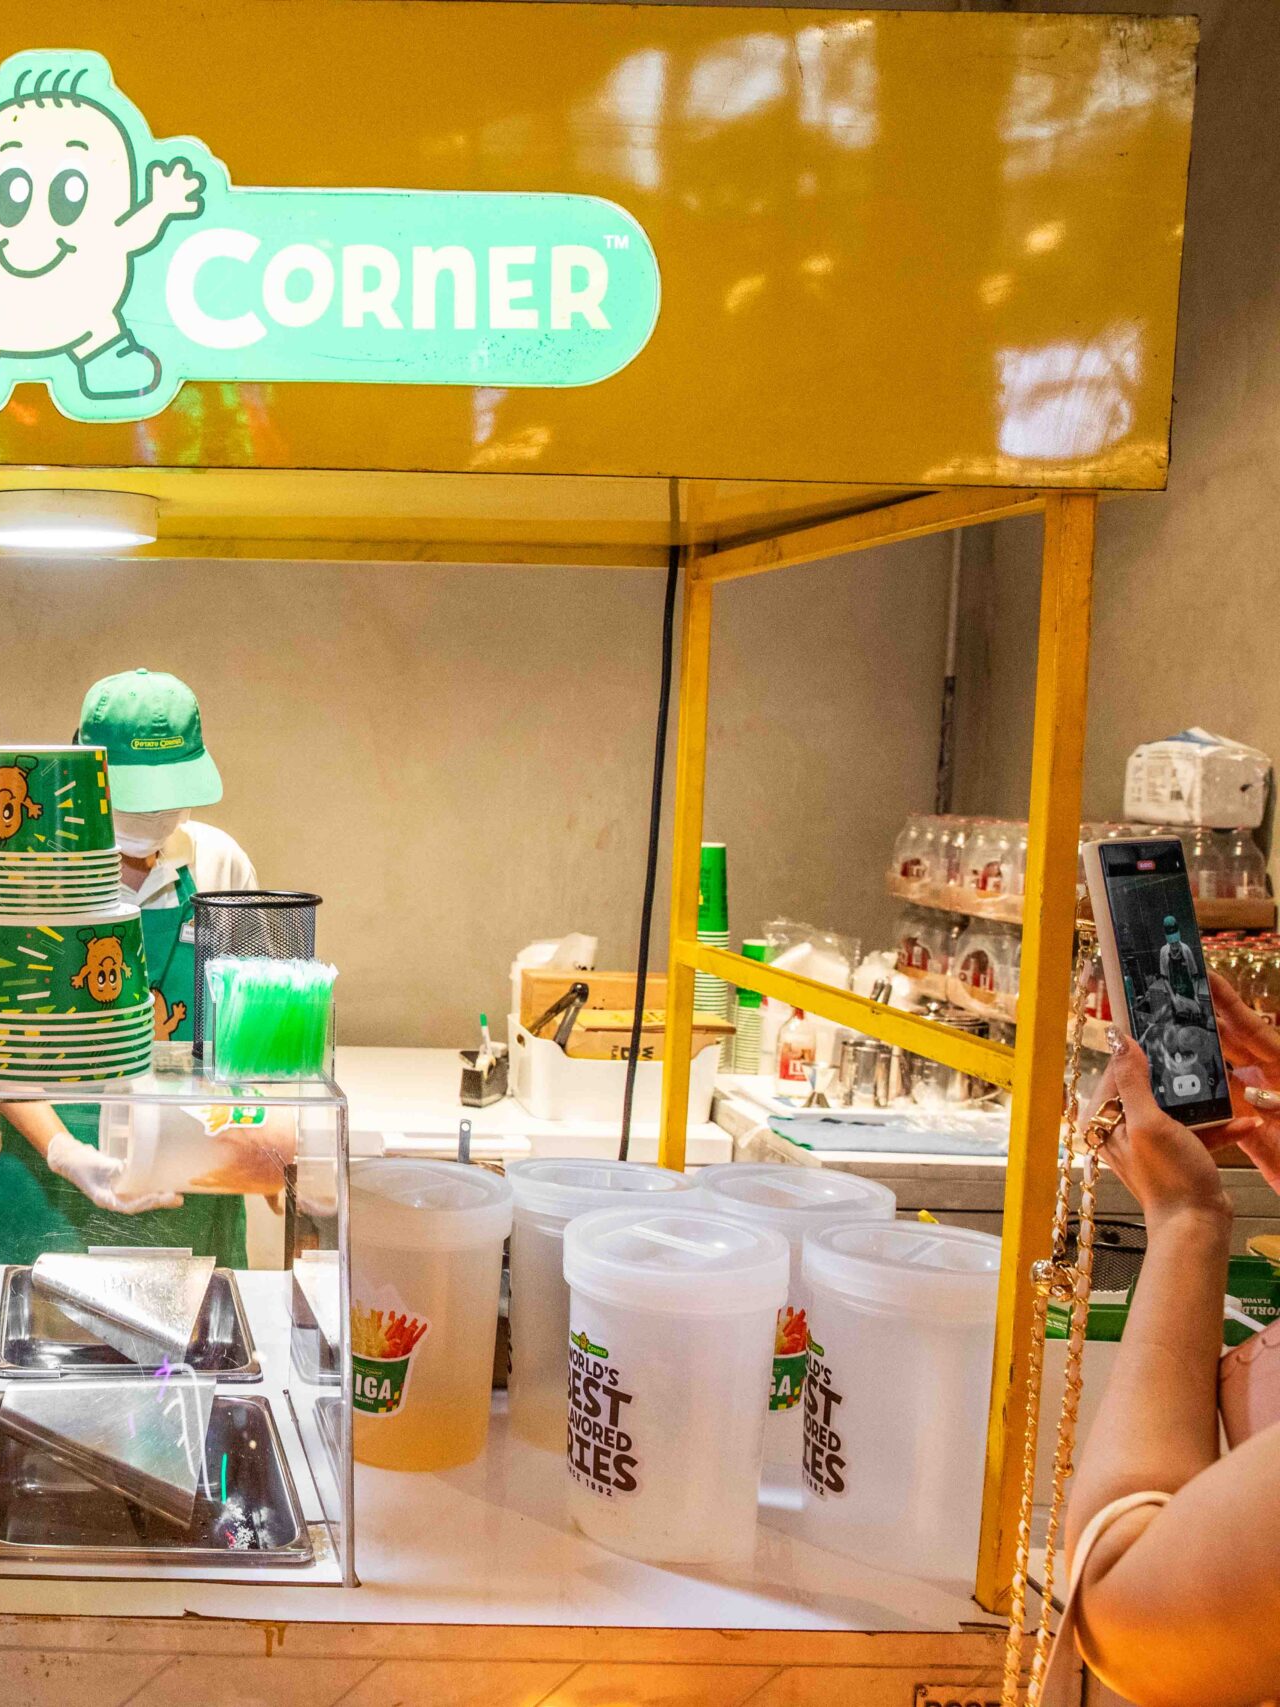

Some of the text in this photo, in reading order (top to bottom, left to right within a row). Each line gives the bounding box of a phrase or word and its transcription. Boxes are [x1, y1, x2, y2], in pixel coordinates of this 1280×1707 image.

[164, 227, 612, 350] CORNER
[354, 1373, 391, 1400] IGA
[585, 1478, 613, 1497] 1992
